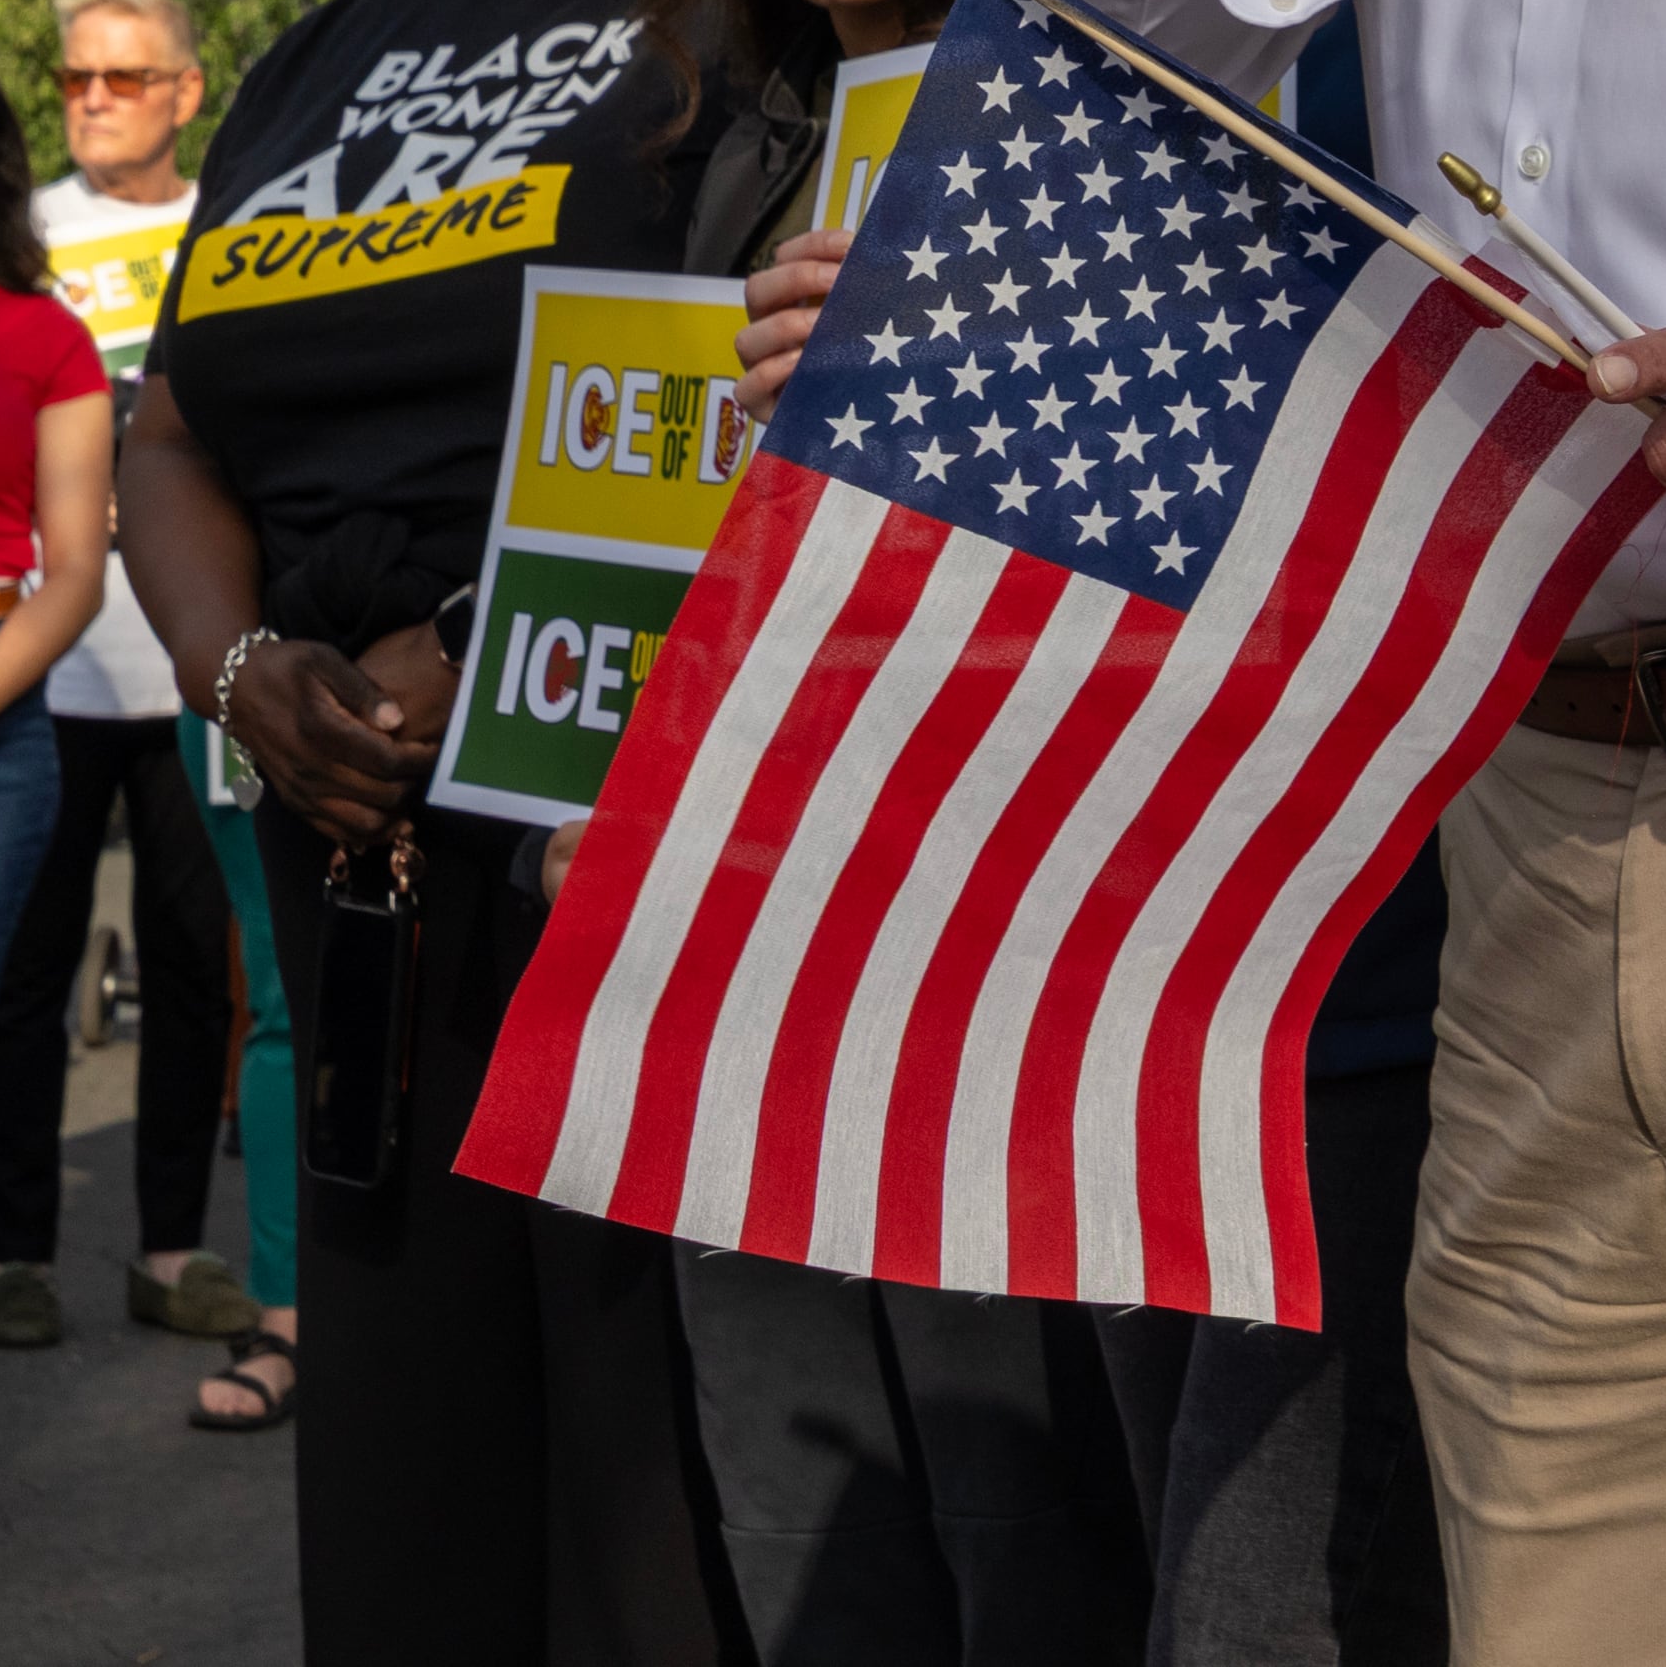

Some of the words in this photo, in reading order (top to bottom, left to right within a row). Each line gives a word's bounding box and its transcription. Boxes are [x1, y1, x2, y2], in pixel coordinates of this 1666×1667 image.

[354, 17, 645, 102] BLACK
[337, 66, 621, 142] WOMEN
[223, 109, 579, 228] ARE
[211, 181, 539, 287] SUPREME
[52, 257, 137, 319] CE
[538, 360, 662, 478] ICE
[658, 373, 706, 427] OUT
[660, 429, 692, 481] OF
[495, 611, 633, 734] ICE
[629, 629, 667, 683] OU
